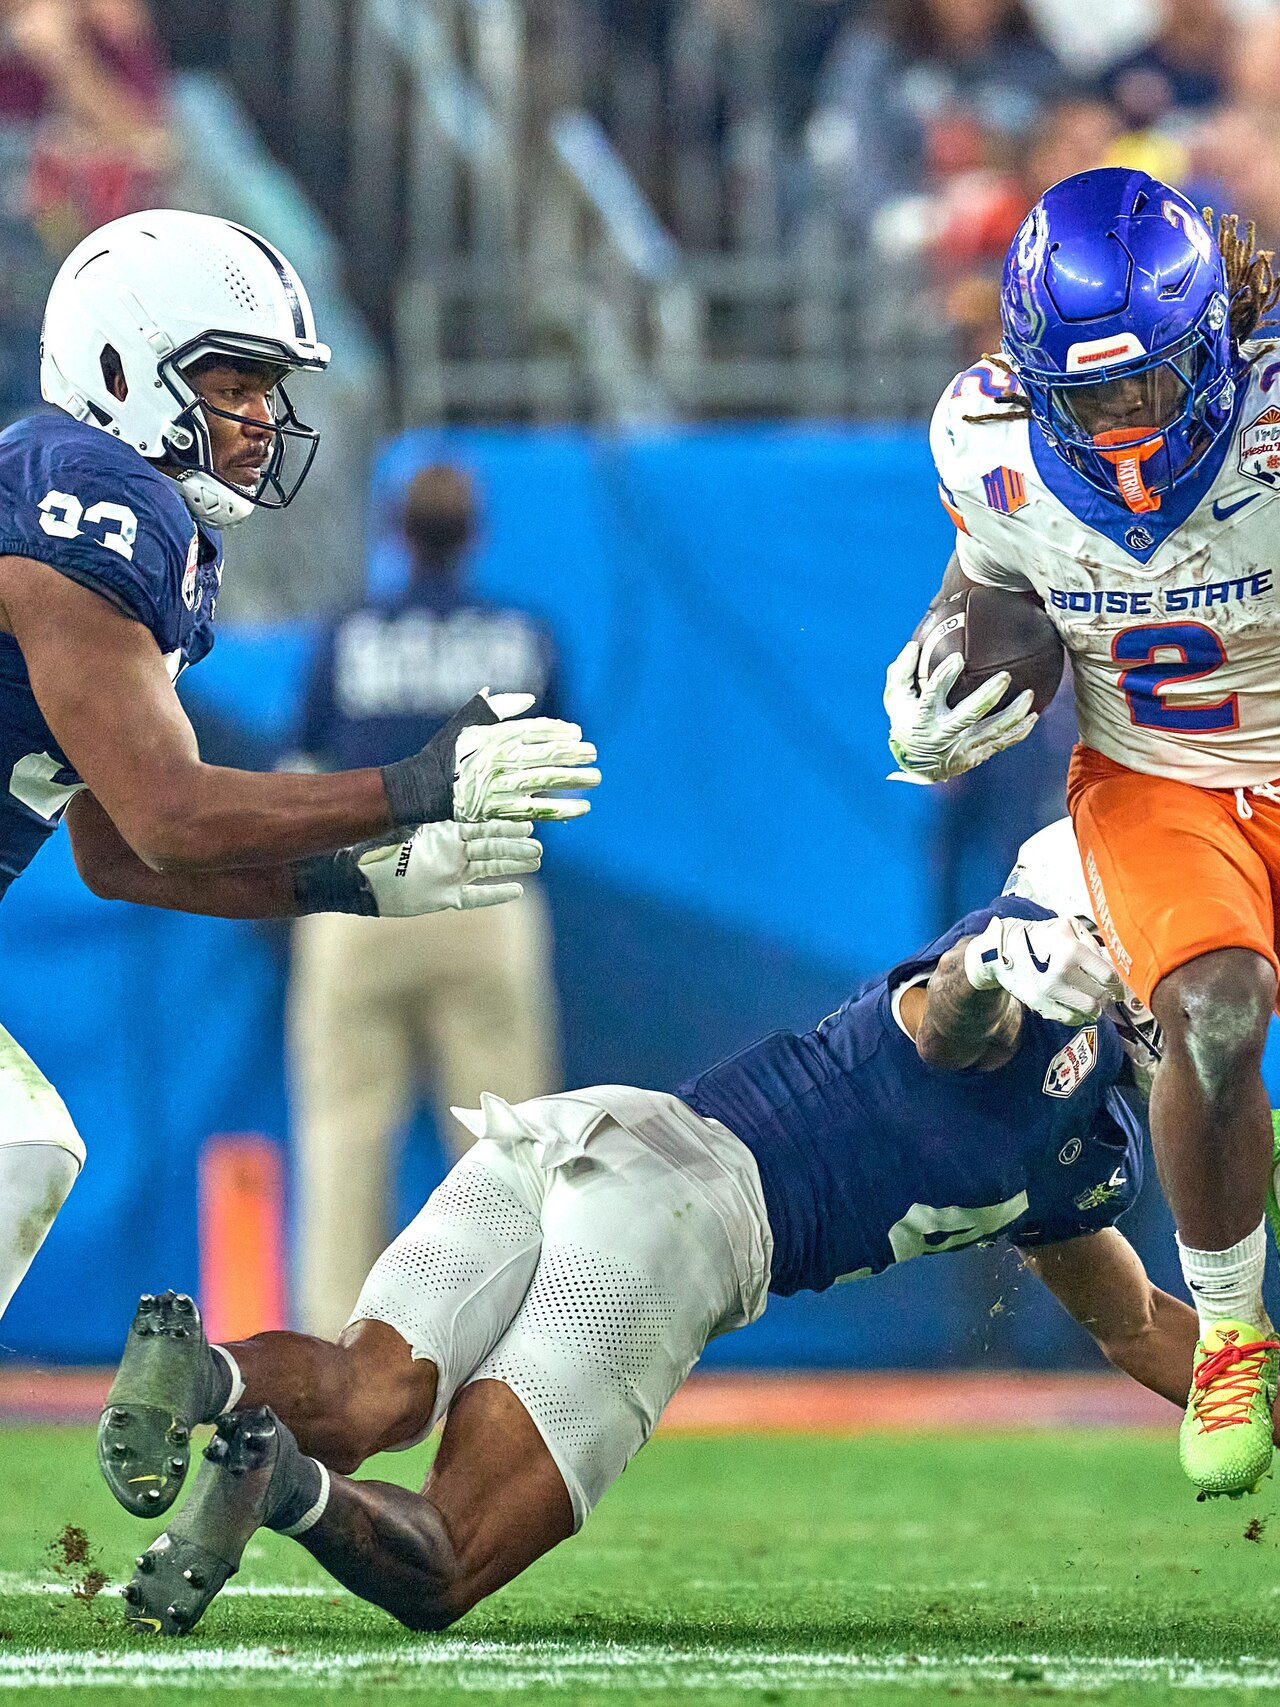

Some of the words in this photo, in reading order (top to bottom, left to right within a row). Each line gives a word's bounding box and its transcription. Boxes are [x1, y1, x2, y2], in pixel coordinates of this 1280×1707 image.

[951, 367, 1019, 399] 2
[1242, 443, 1275, 459] Fiesta
[1118, 458, 1145, 503] NXTRND
[1048, 586, 1153, 614] BOISE
[1165, 569, 1273, 612] STATE
[1111, 621, 1240, 734] 2
